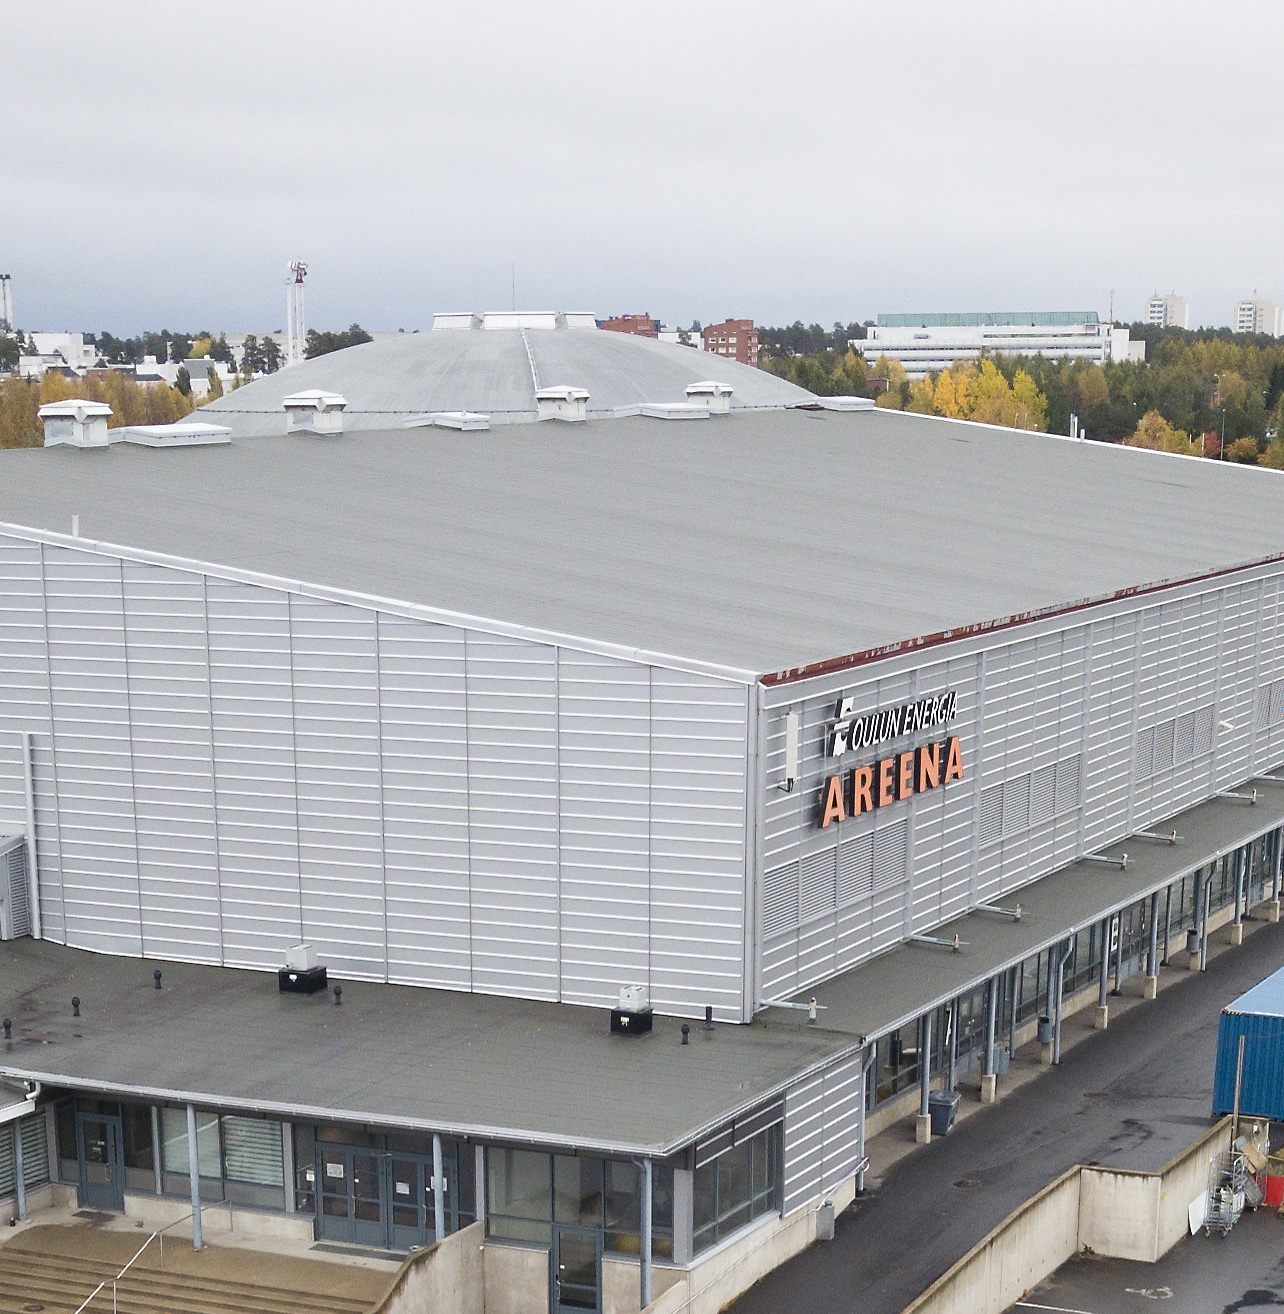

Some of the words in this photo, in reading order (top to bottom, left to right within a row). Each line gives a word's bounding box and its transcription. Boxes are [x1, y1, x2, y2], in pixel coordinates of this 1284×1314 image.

[851, 706, 902, 751] OULUN
[903, 691, 959, 733] ENERGIA
[821, 735, 965, 829] AREENA
